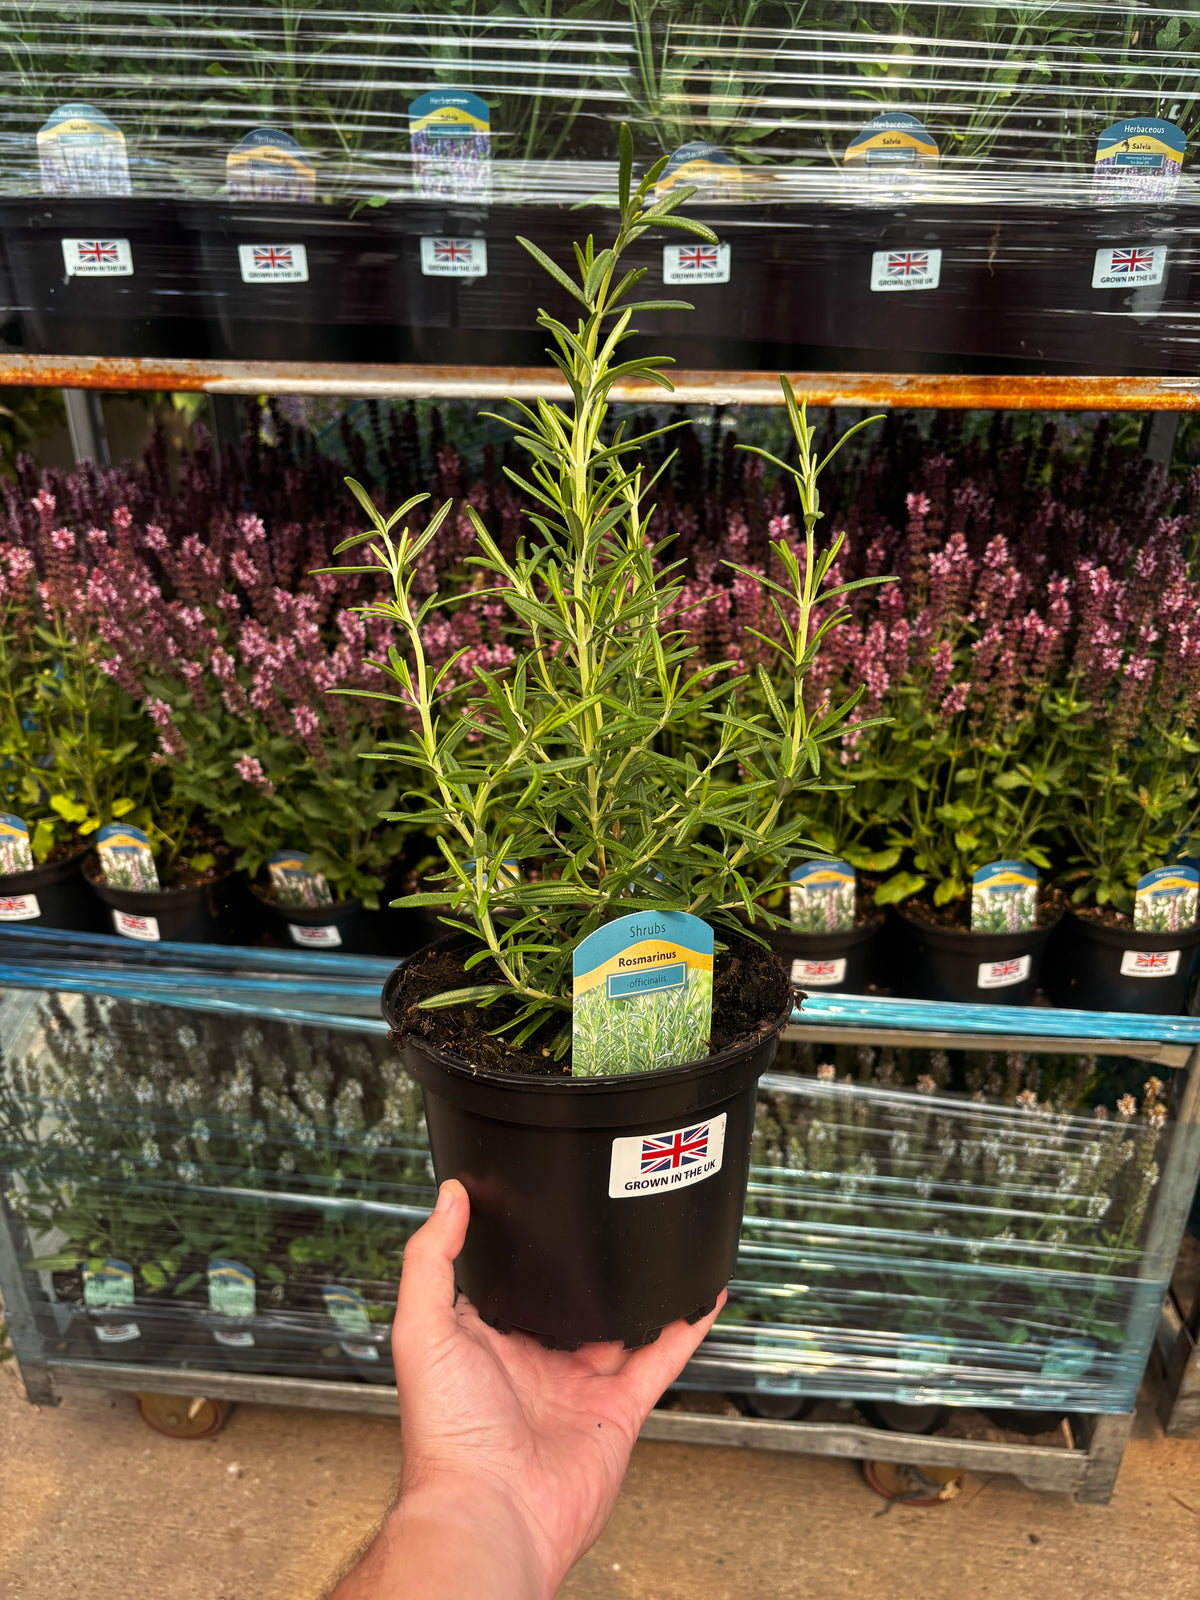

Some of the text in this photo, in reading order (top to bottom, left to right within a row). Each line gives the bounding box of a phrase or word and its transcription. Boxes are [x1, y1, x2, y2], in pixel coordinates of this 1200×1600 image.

[1124, 125, 1165, 134] Herbaceous
[1132, 142, 1151, 150] Salvia
[630, 922, 666, 938] Shrubs
[618, 951, 677, 967] Rosmarinus
[629, 974, 667, 989] officinalis
[624, 1159, 716, 1191] GROWN IN THE UK
